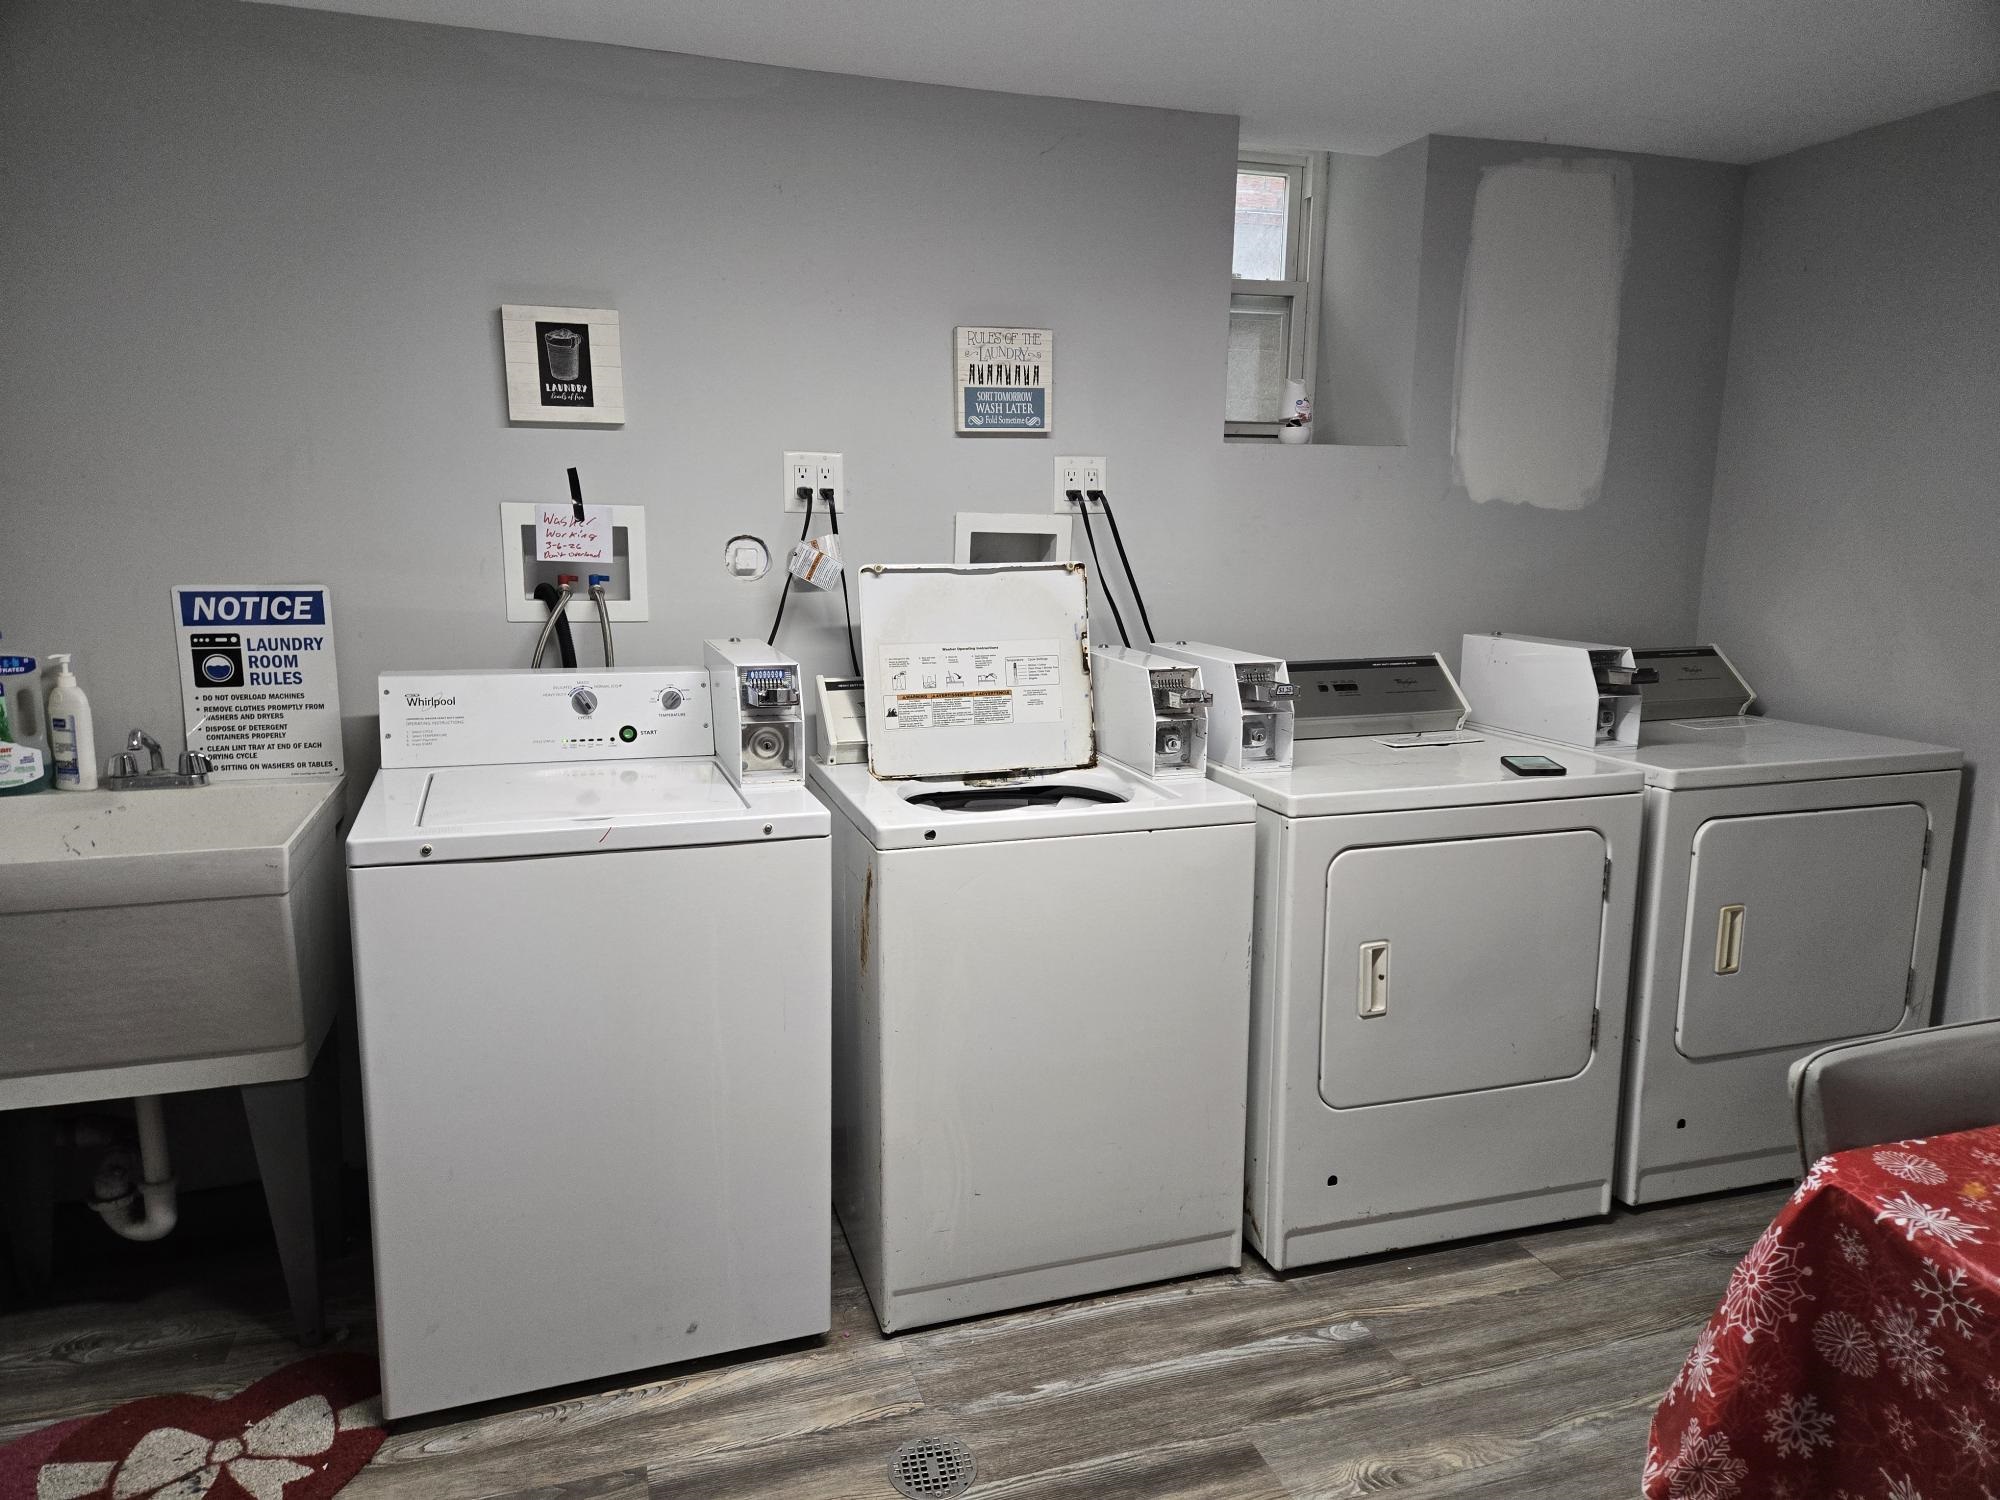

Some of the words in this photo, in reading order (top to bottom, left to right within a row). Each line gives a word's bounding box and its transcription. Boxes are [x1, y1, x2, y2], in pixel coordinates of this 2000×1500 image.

[968, 331, 1002, 345] RULES
[1005, 333, 1018, 344] OF
[1022, 333, 1042, 345] THE
[979, 346, 1030, 362] LAUNDRY
[545, 383, 587, 393] LAUNDRY
[977, 392, 993, 401] SORT
[994, 392, 1033, 401] TOMORROW
[976, 403, 1002, 414] WASH
[1006, 403, 1034, 414] LATER
[985, 416, 997, 424] Fold
[998, 416, 1025, 424] Sometime
[546, 528, 597, 541] Working
[193, 596, 313, 621] NOTICE
[246, 637, 323, 651] LAUNDRY
[248, 655, 298, 668] ROOM
[250, 672, 303, 685] RULES
[406, 696, 456, 708] Whirlpool
